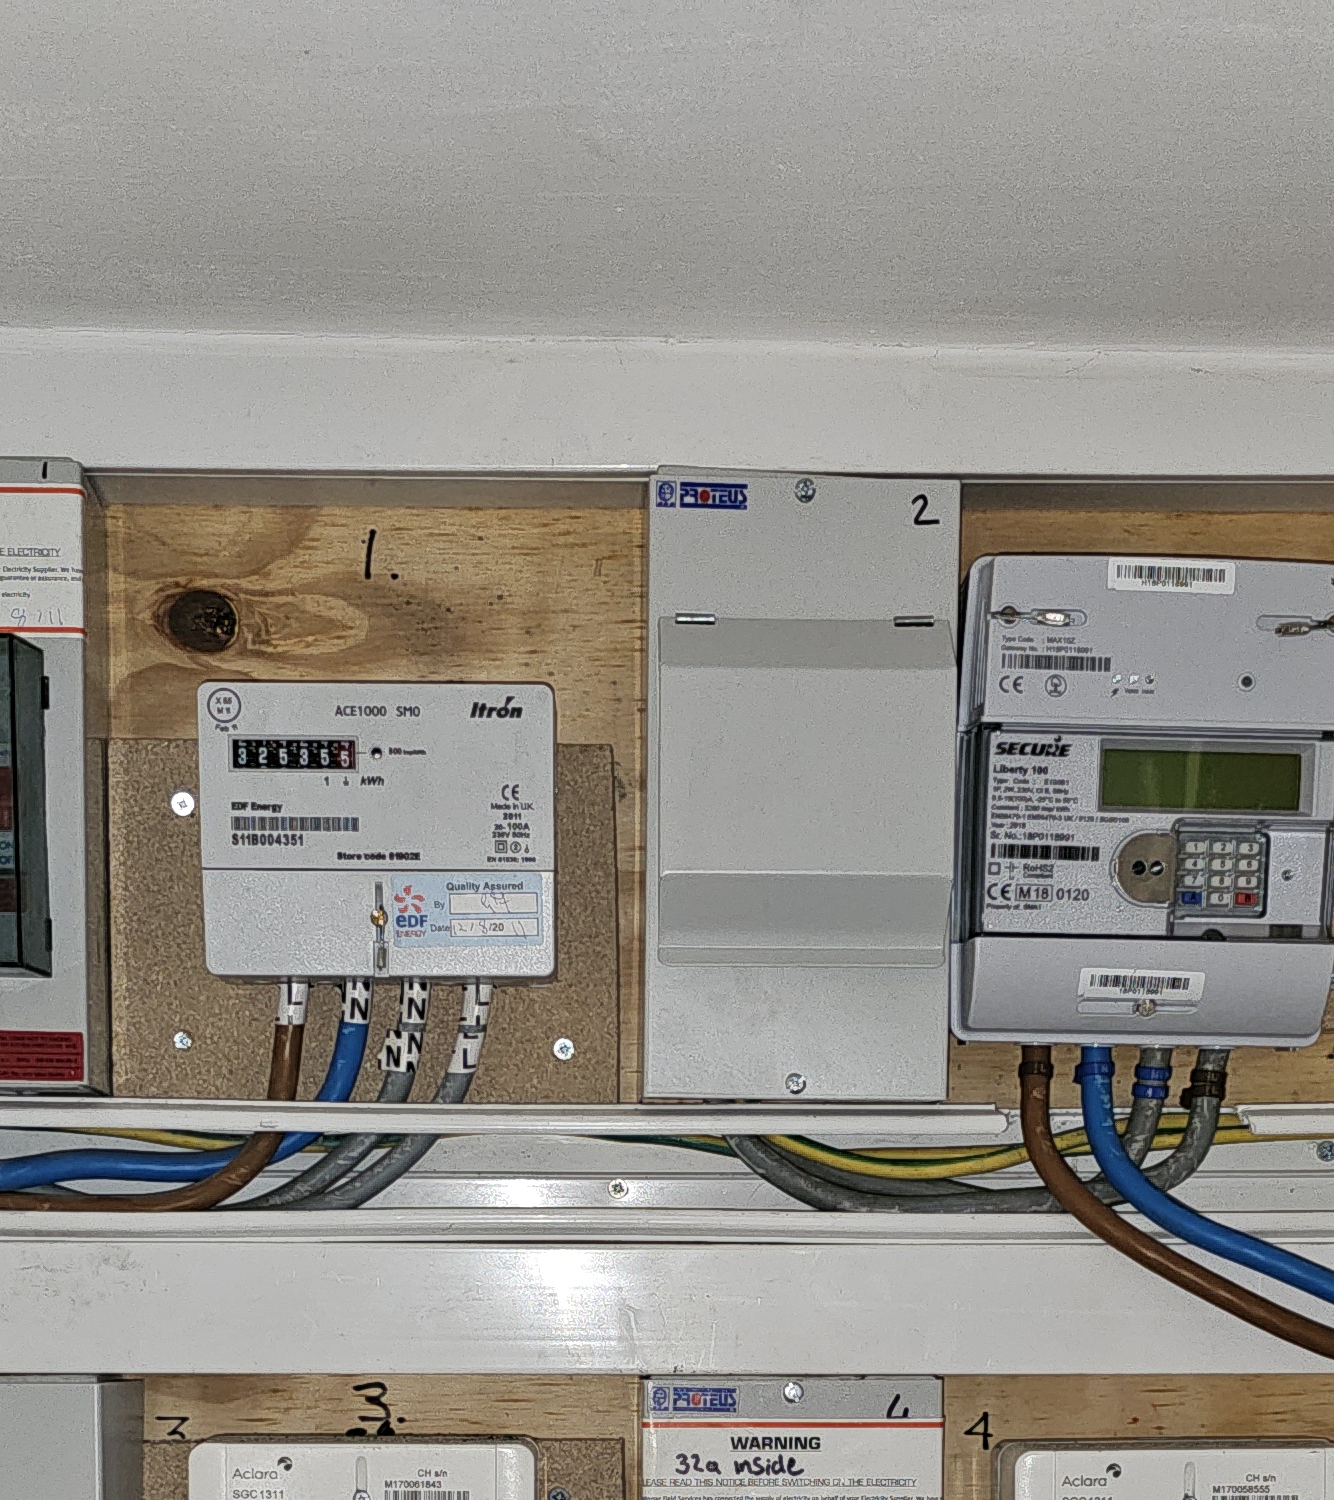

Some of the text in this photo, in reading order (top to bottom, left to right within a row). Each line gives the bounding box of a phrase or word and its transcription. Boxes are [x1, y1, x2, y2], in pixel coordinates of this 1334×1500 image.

[679, 481, 748, 510] PROTEUS
[911, 493, 940, 526] 2
[334, 705, 387, 717] ACE1000
[994, 735, 1073, 757] SECURE
[993, 764, 1049, 776] Liberty 100
[231, 834, 304, 846] S11B004351
[446, 881, 524, 892] Quality Assured
[1056, 888, 1090, 901] 0120
[672, 1386, 737, 1413] PROTEUS
[964, 1411, 994, 1451] 4
[730, 1436, 822, 1450] WARNING
[734, 1454, 805, 1477] inside
[232, 1468, 279, 1480] Aclara
[1061, 1475, 1108, 1488] Aclara
